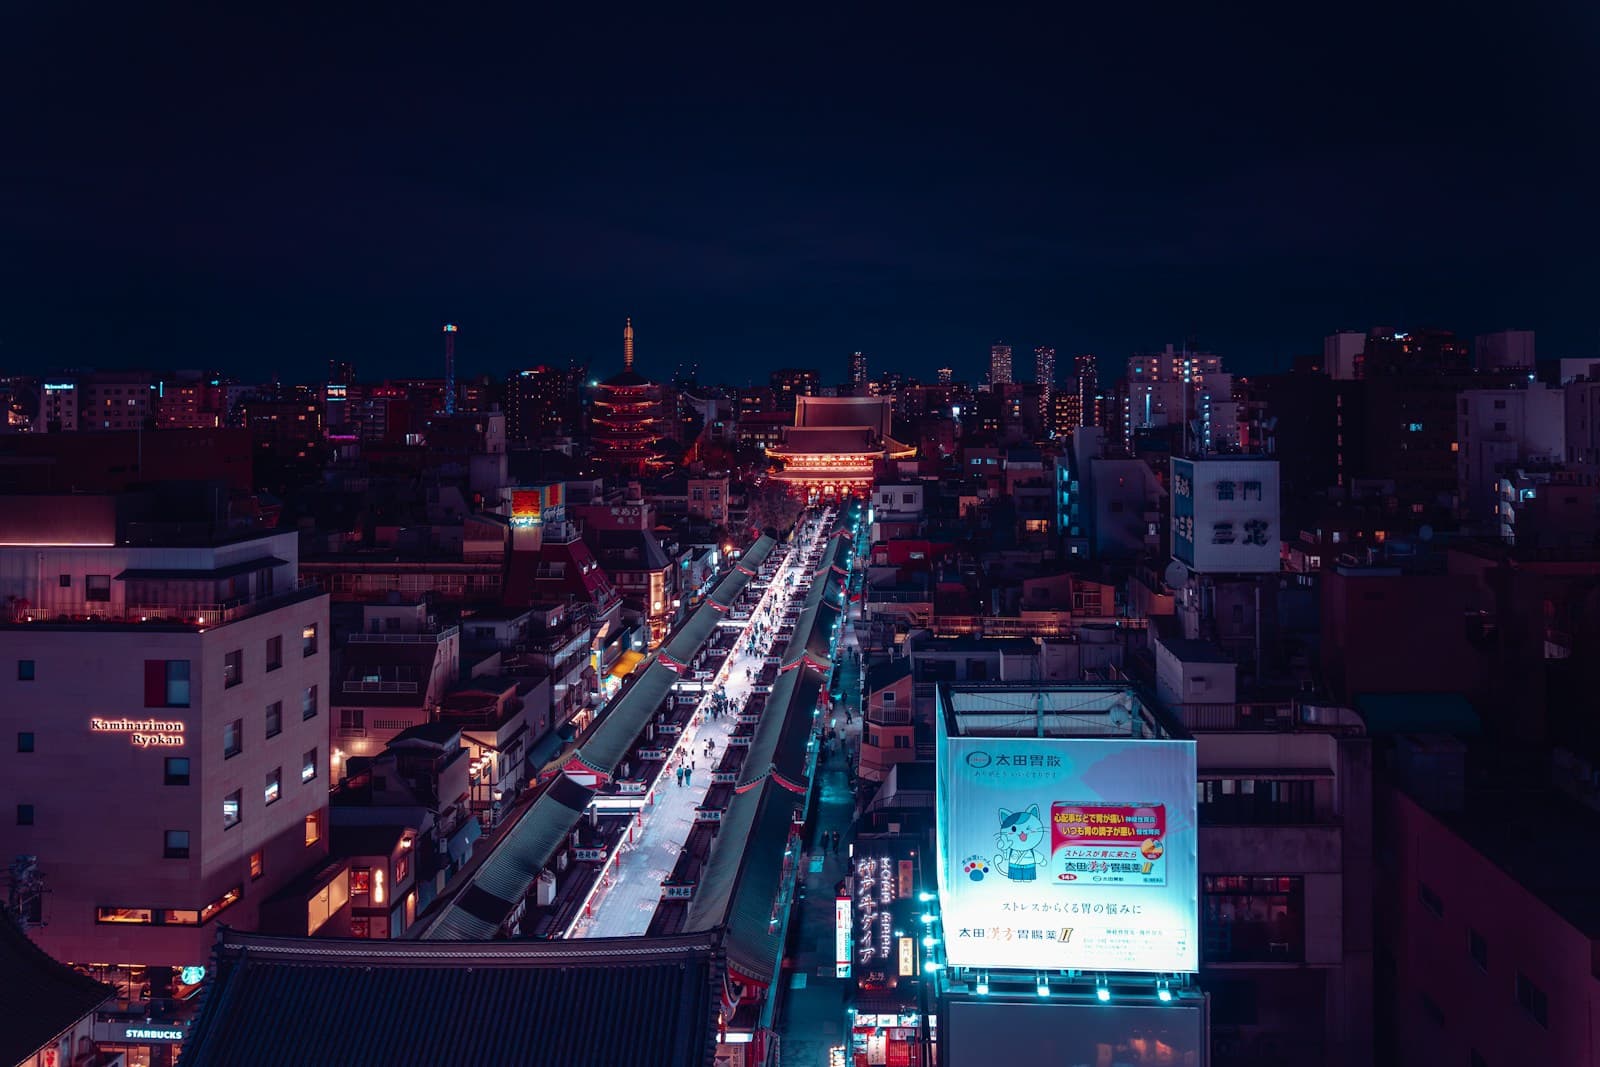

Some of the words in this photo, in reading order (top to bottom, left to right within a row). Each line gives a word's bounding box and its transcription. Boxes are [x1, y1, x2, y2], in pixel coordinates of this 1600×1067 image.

[1216, 481, 1262, 501] 雷門
[1212, 520, 1269, 546] 三定
[91, 718, 184, 731] Kaminarimon
[132, 733, 184, 748] Ryokan
[995, 754, 1062, 767] 太田胃散
[1054, 813, 1125, 824] 心配事などで胃が痛い
[1062, 826, 1136, 836] いつも胃の調子が悪い
[1002, 901, 1142, 916] ストレスからくる胃の悩みに
[125, 1029, 183, 1041] STARBUCKS
